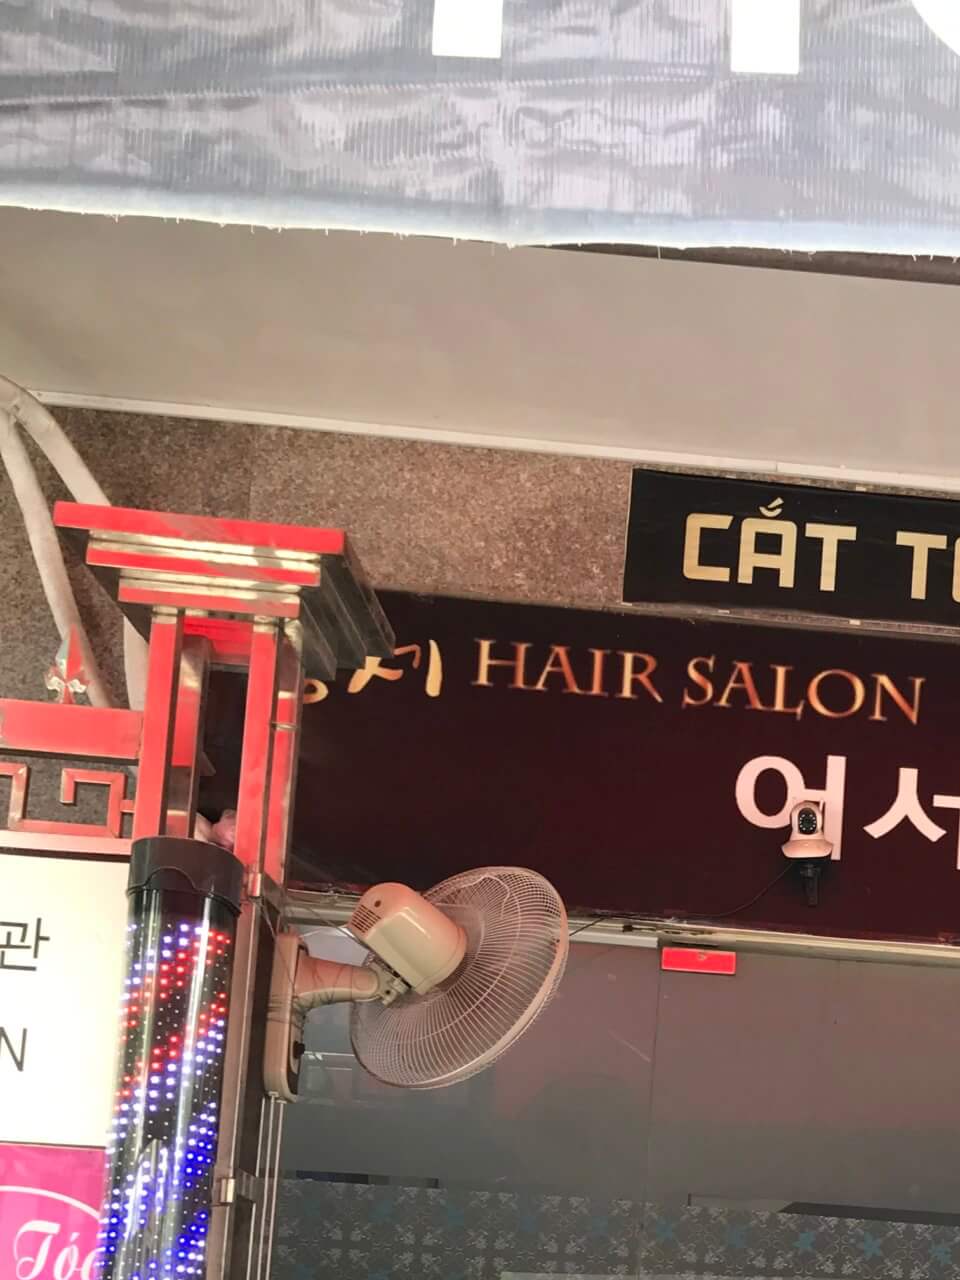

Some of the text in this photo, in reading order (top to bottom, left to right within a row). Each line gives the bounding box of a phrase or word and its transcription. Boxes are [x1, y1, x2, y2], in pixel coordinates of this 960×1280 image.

[682, 497, 857, 593] CẮT
[471, 638, 926, 725] HAIR SALON
